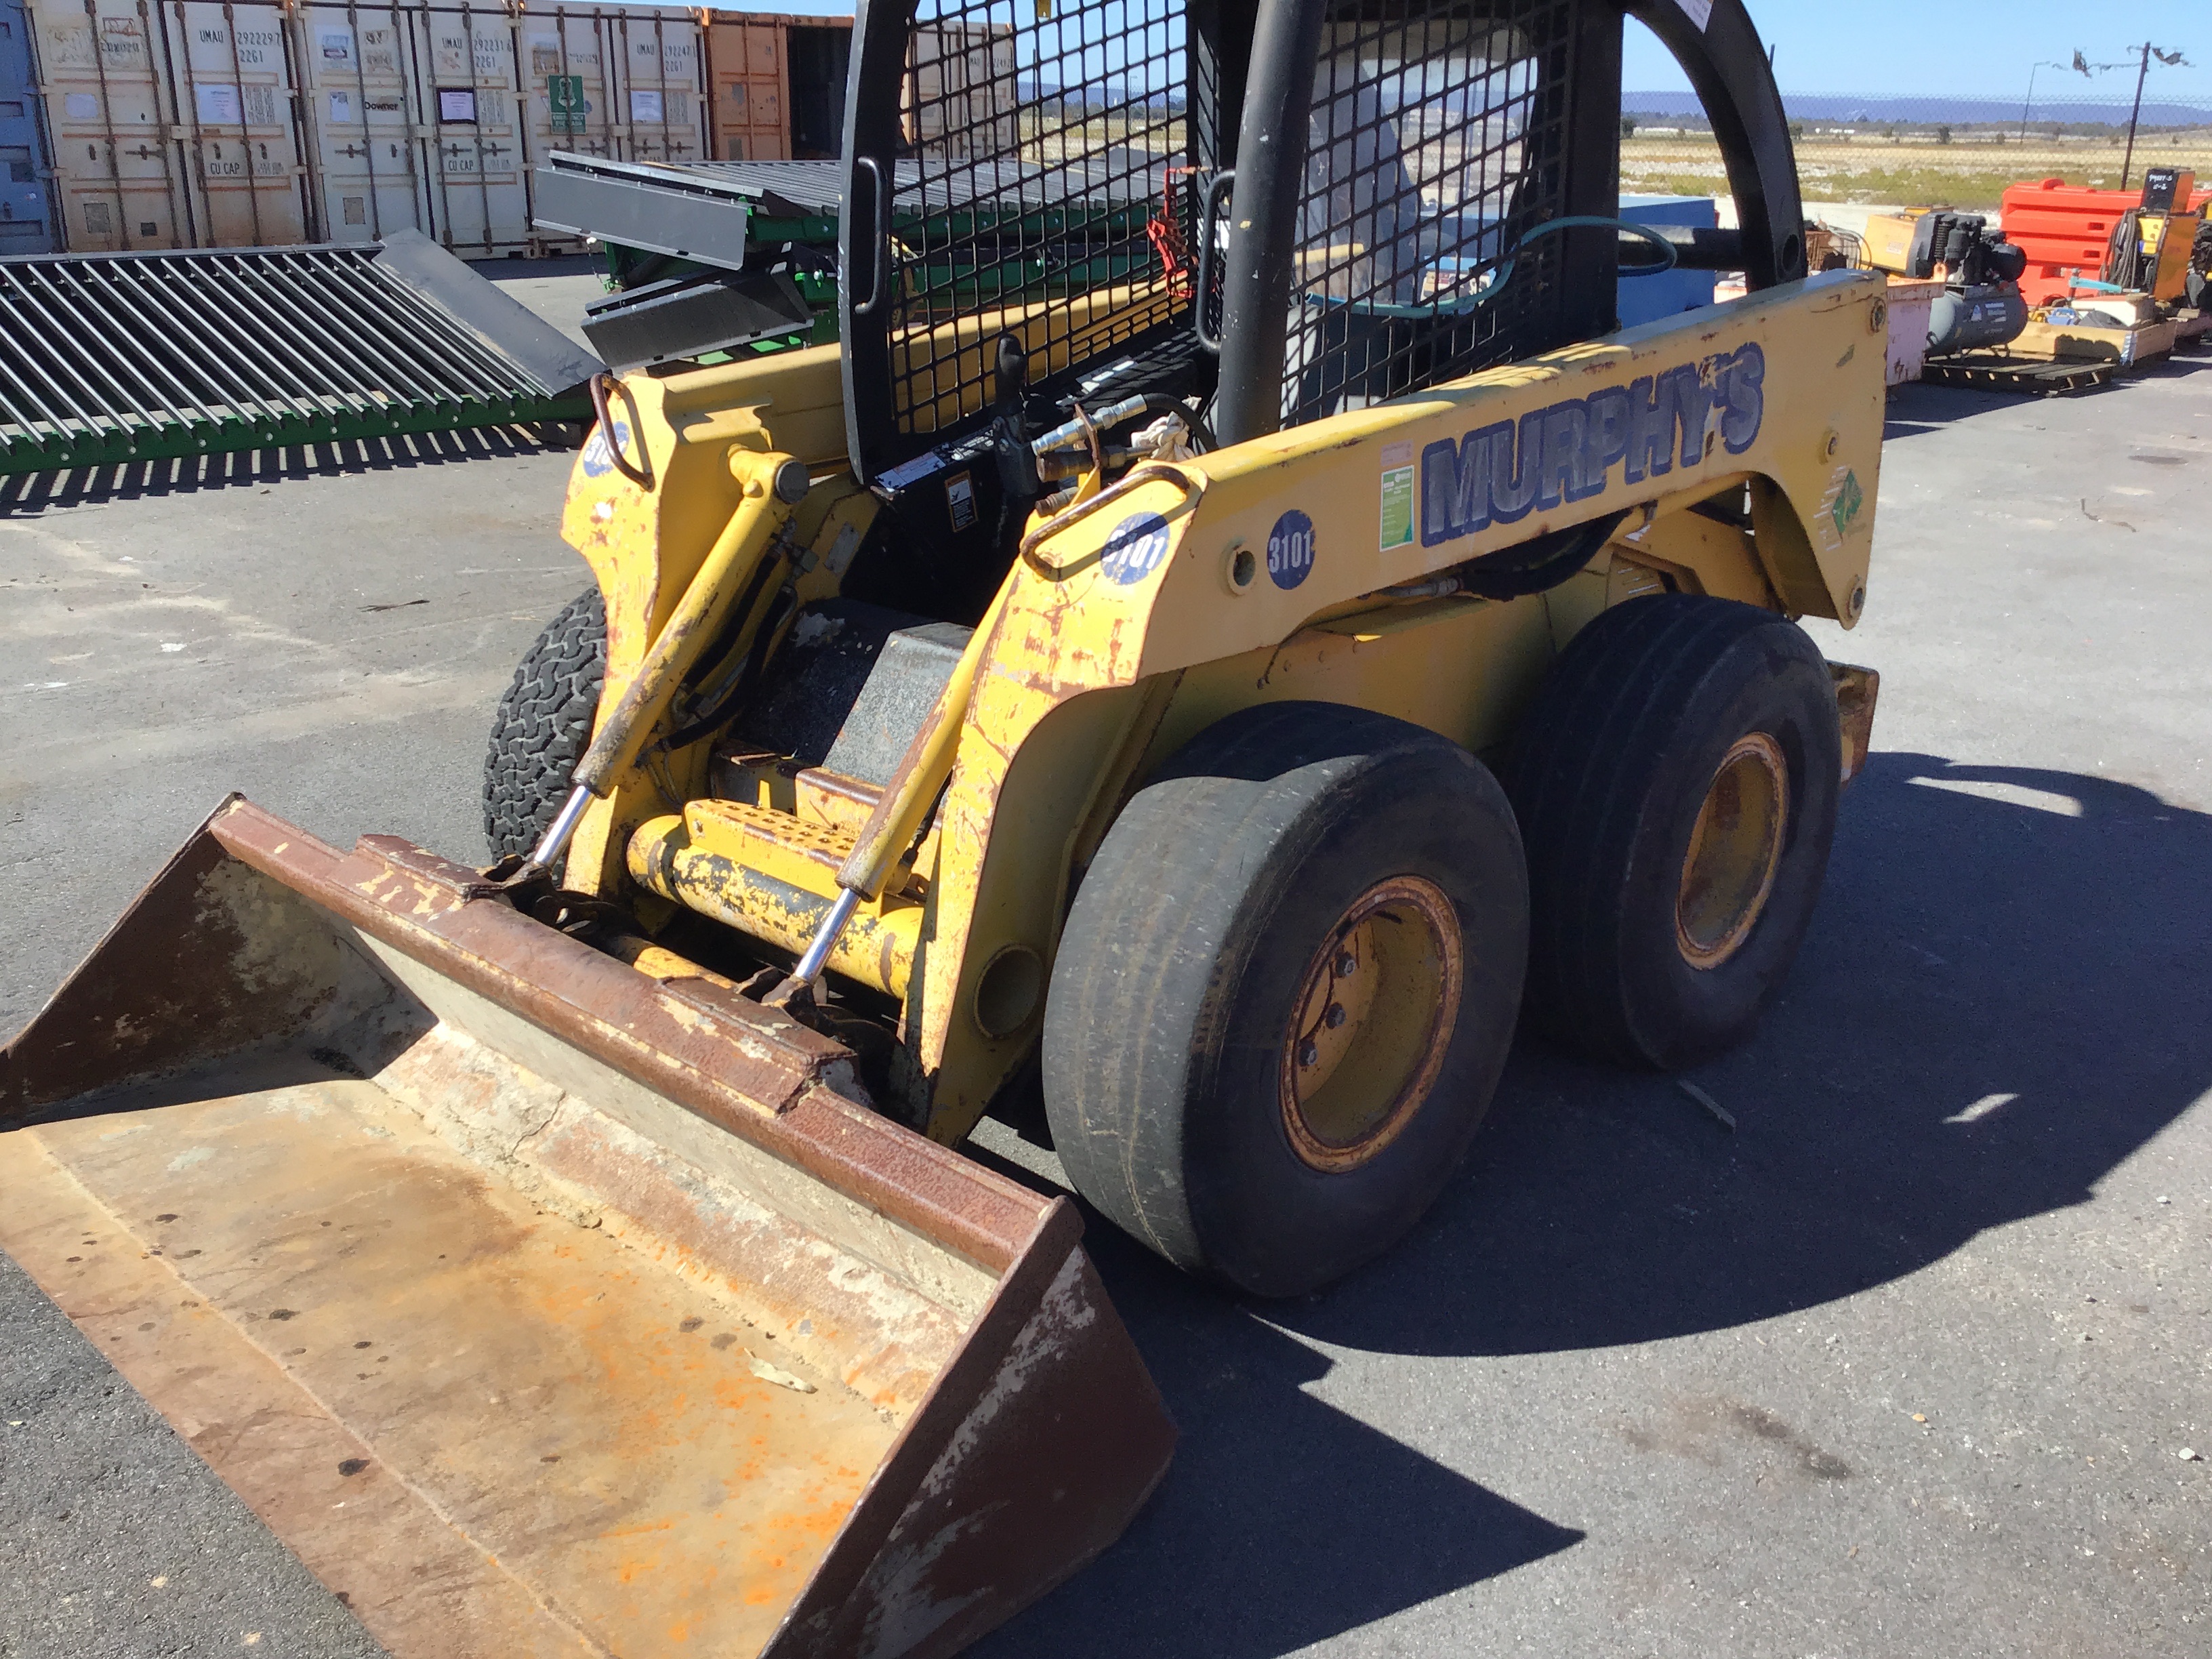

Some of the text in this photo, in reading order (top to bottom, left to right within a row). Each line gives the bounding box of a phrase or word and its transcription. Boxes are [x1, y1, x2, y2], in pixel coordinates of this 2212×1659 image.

[199, 29, 224, 44] UMAU
[441, 37, 463, 50] UMAU
[365, 101, 398, 110] Downer
[224, 163, 240, 174] CAP
[1421, 342, 1765, 548] MURPHY'S
[1101, 529, 1166, 569] 3101
[1269, 529, 1311, 573] 3101
